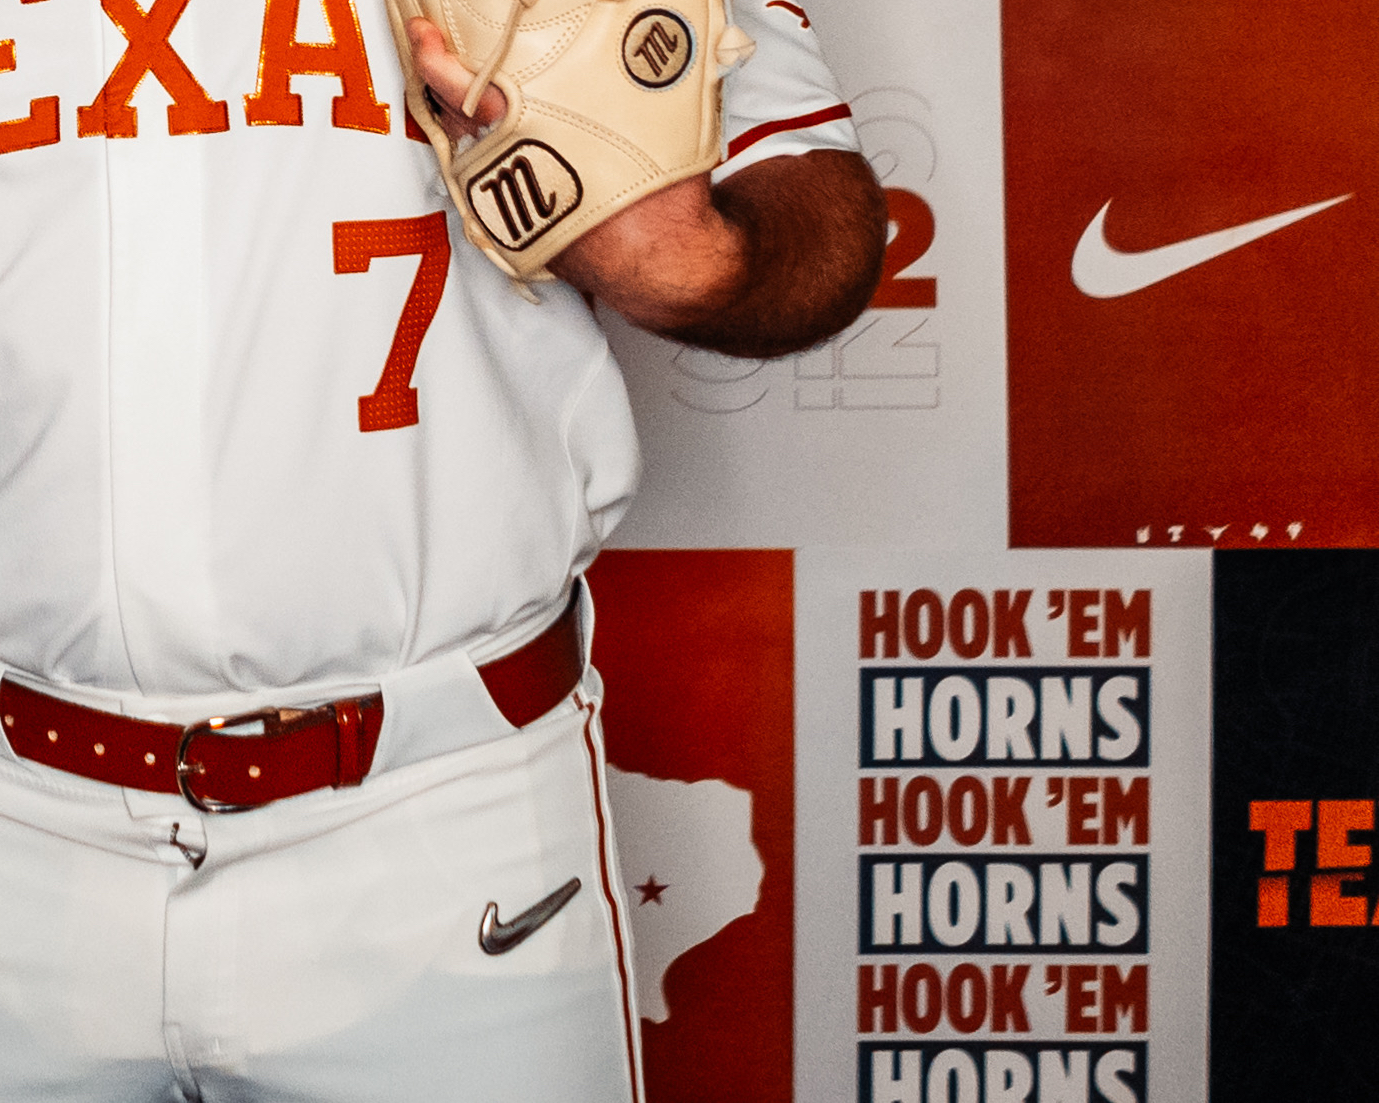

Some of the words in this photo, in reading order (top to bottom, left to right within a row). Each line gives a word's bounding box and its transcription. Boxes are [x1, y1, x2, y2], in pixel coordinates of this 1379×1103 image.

[332, 210, 452, 432] 7
[859, 587, 1034, 660] HOOK
[872, 674, 1142, 762] HORNS
[858, 774, 1032, 847] HOOK
[871, 862, 1141, 946] HORNS
[1249, 799, 1379, 927] TE
[857, 961, 1031, 1035] HOOK
